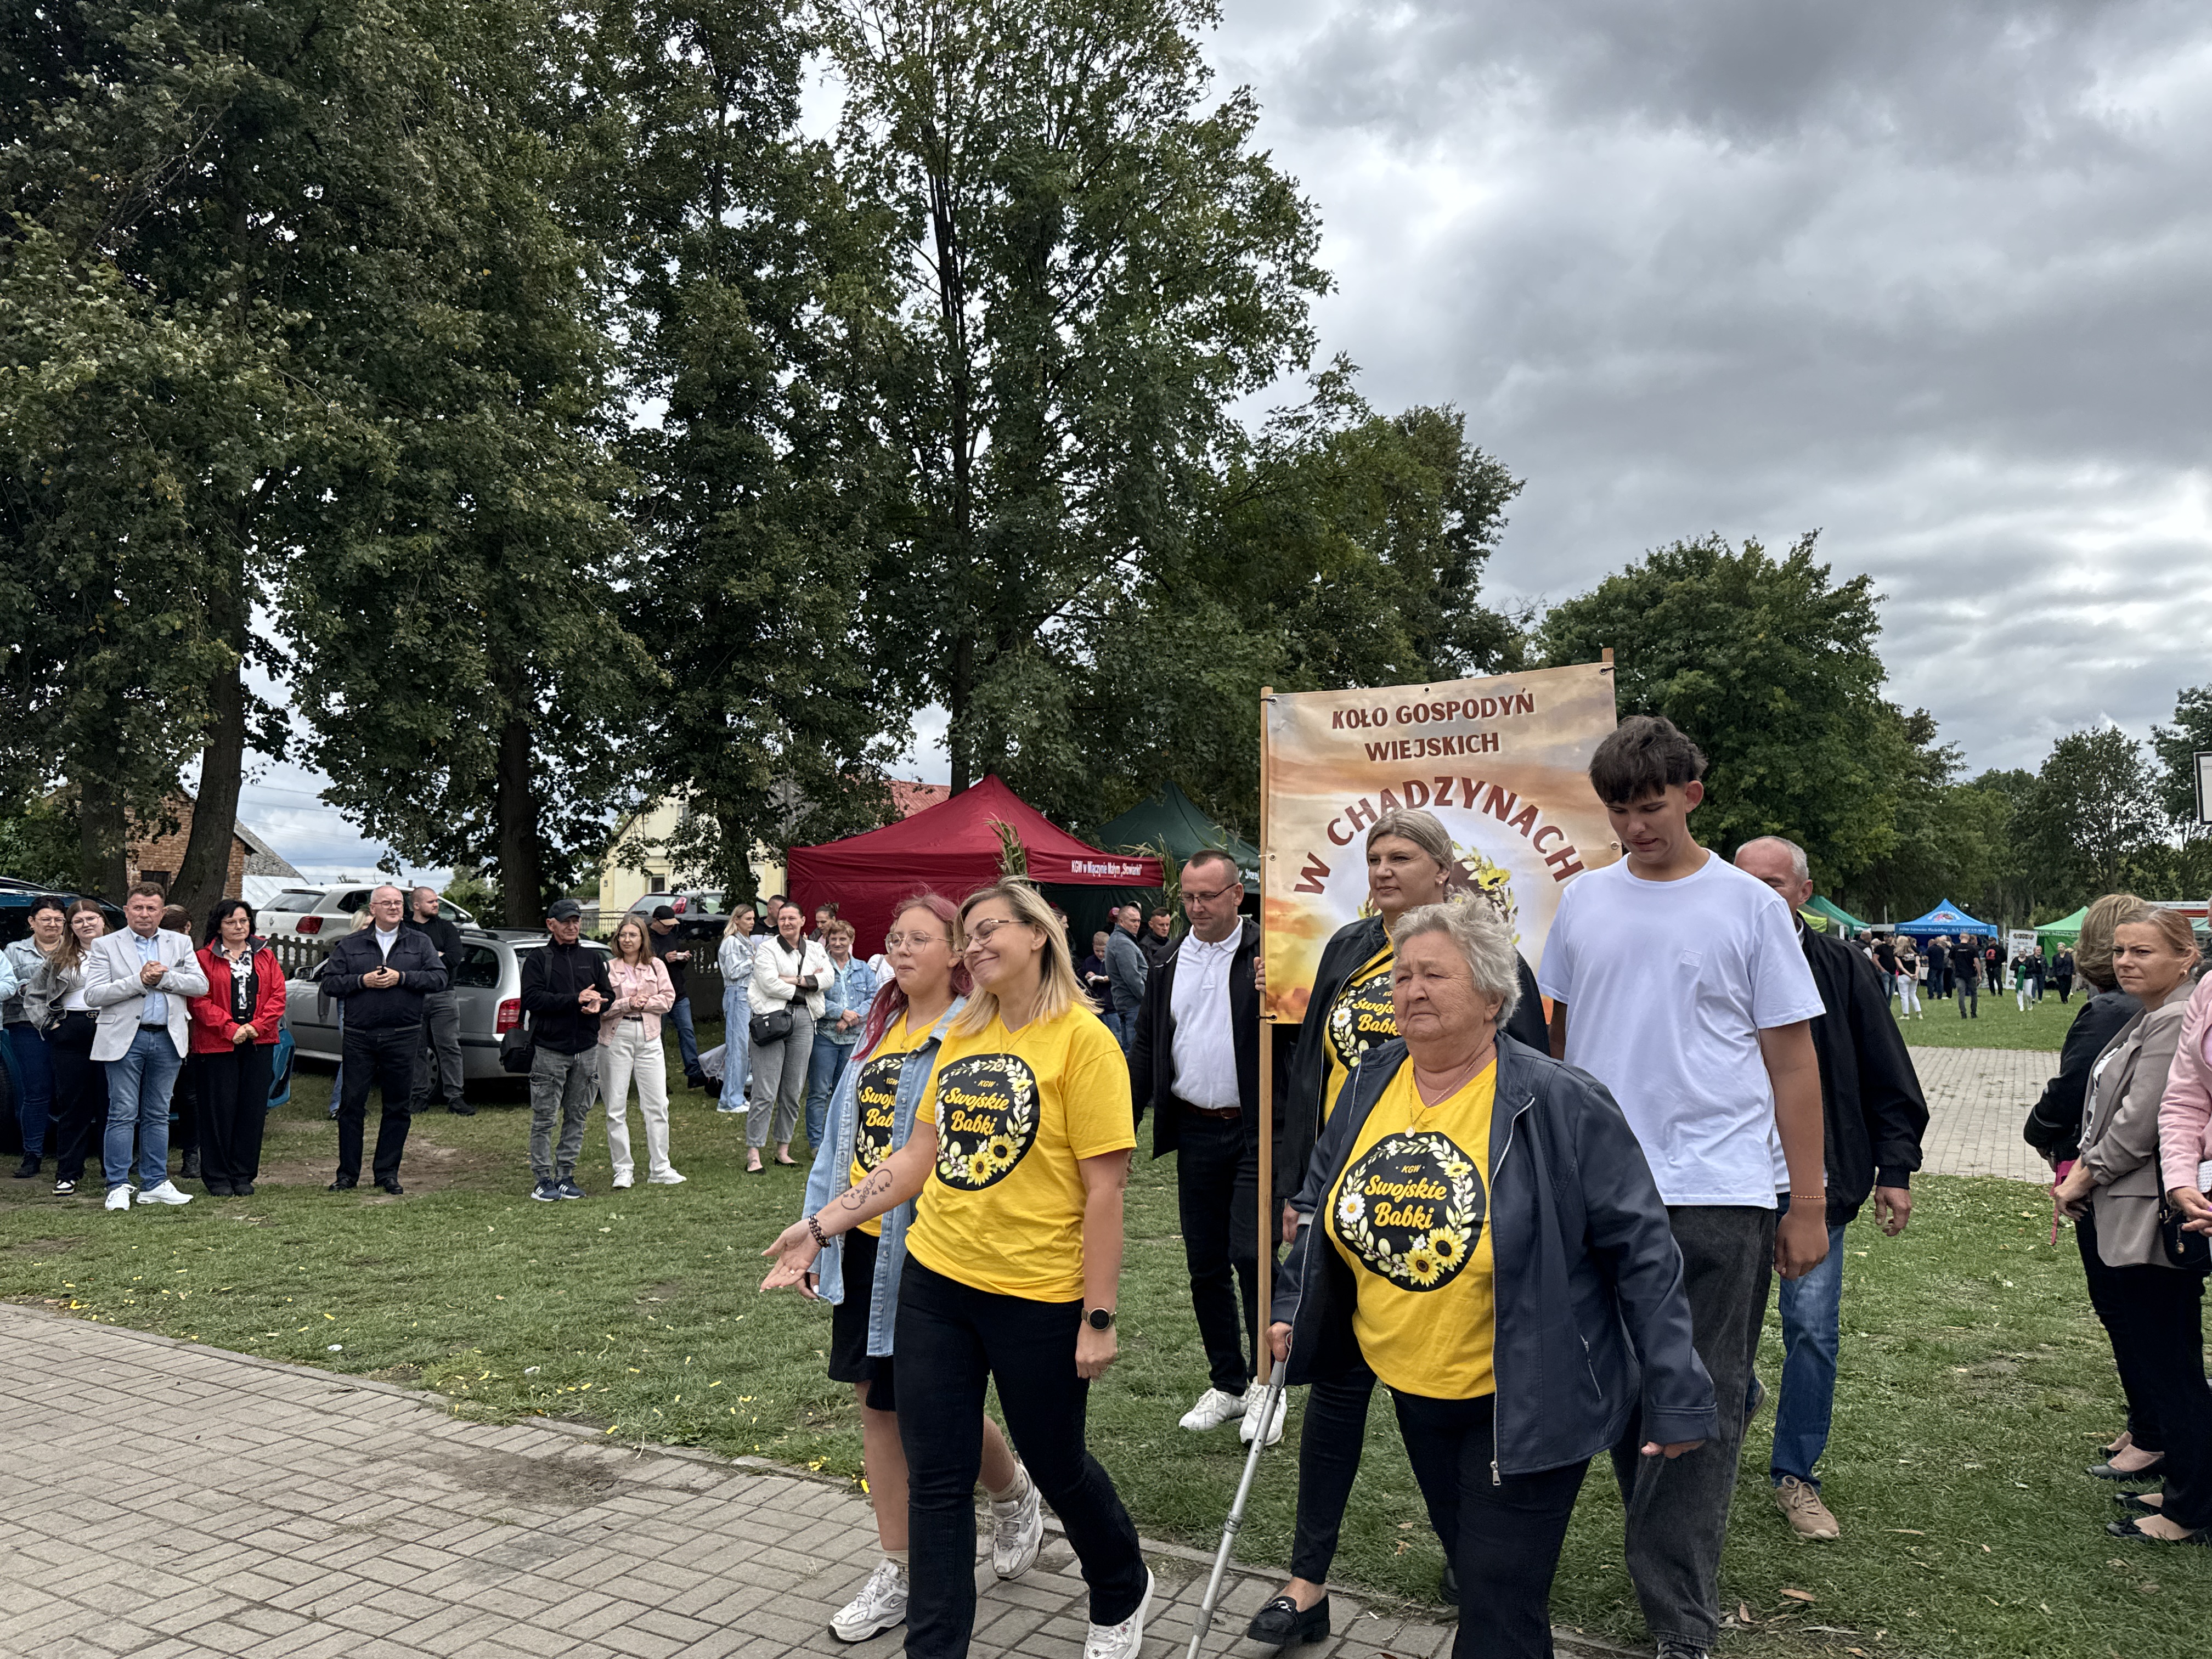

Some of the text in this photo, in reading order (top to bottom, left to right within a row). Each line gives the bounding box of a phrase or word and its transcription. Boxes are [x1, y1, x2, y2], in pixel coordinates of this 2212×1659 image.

[1332, 688, 1534, 729] KOŁO GOSPODYŃ
[1365, 733, 1499, 761] WIEJSKICH
[1071, 860, 1083, 873] KGW
[1083, 864, 1087, 873] w
[1294, 851, 1330, 895] W
[1352, 997, 1395, 1016] Swojs
[1357, 1014, 1402, 1036] Babk
[861, 1086, 896, 1110] Swojs
[944, 1087, 1010, 1112] Swojskie
[866, 1108, 895, 1127] Bab
[951, 1110, 998, 1136] Babki
[1401, 1164, 1421, 1173] KGW
[1364, 1175, 1447, 1203] Swojskie
[1374, 1201, 1435, 1230] Babki
